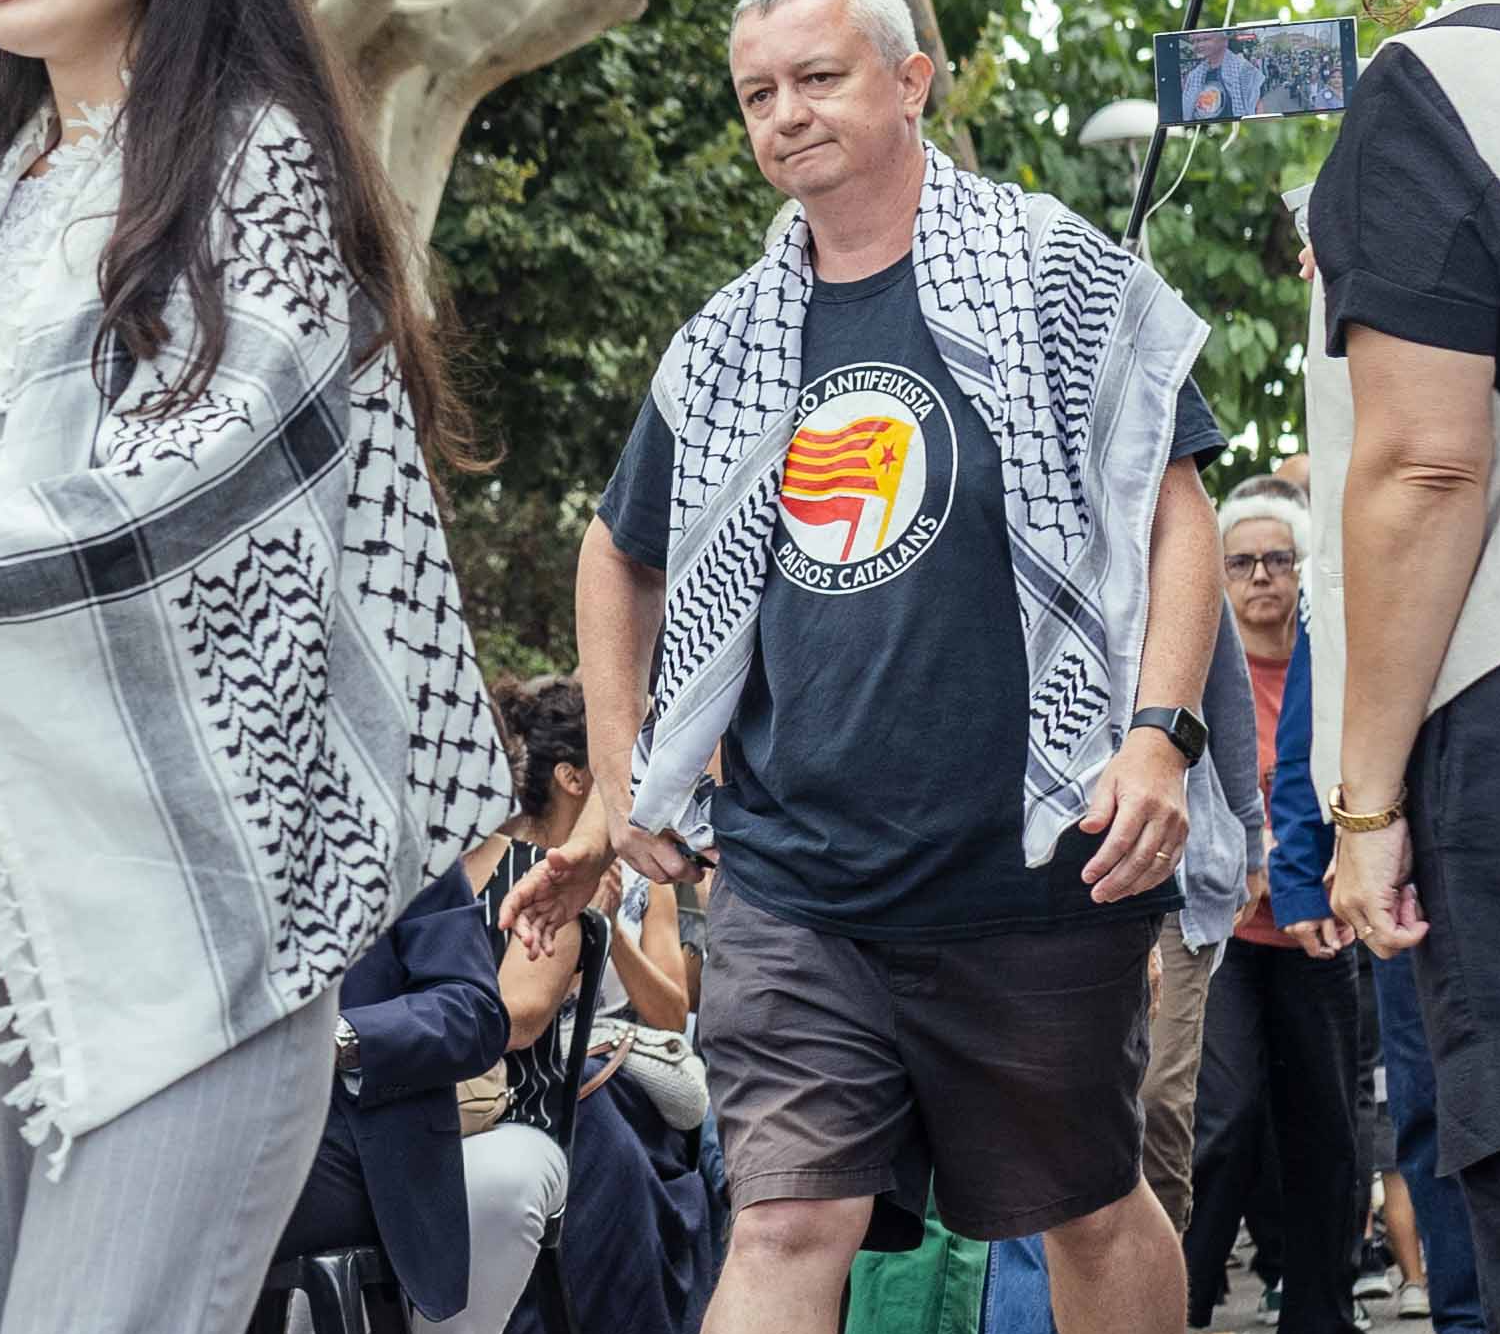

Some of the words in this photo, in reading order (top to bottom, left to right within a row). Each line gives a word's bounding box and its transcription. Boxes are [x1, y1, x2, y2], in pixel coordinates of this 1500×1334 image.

[824, 370, 935, 422] ANTIFEIXISTA
[778, 541, 833, 588] PAÏSOS
[838, 514, 938, 589] CATALANS
